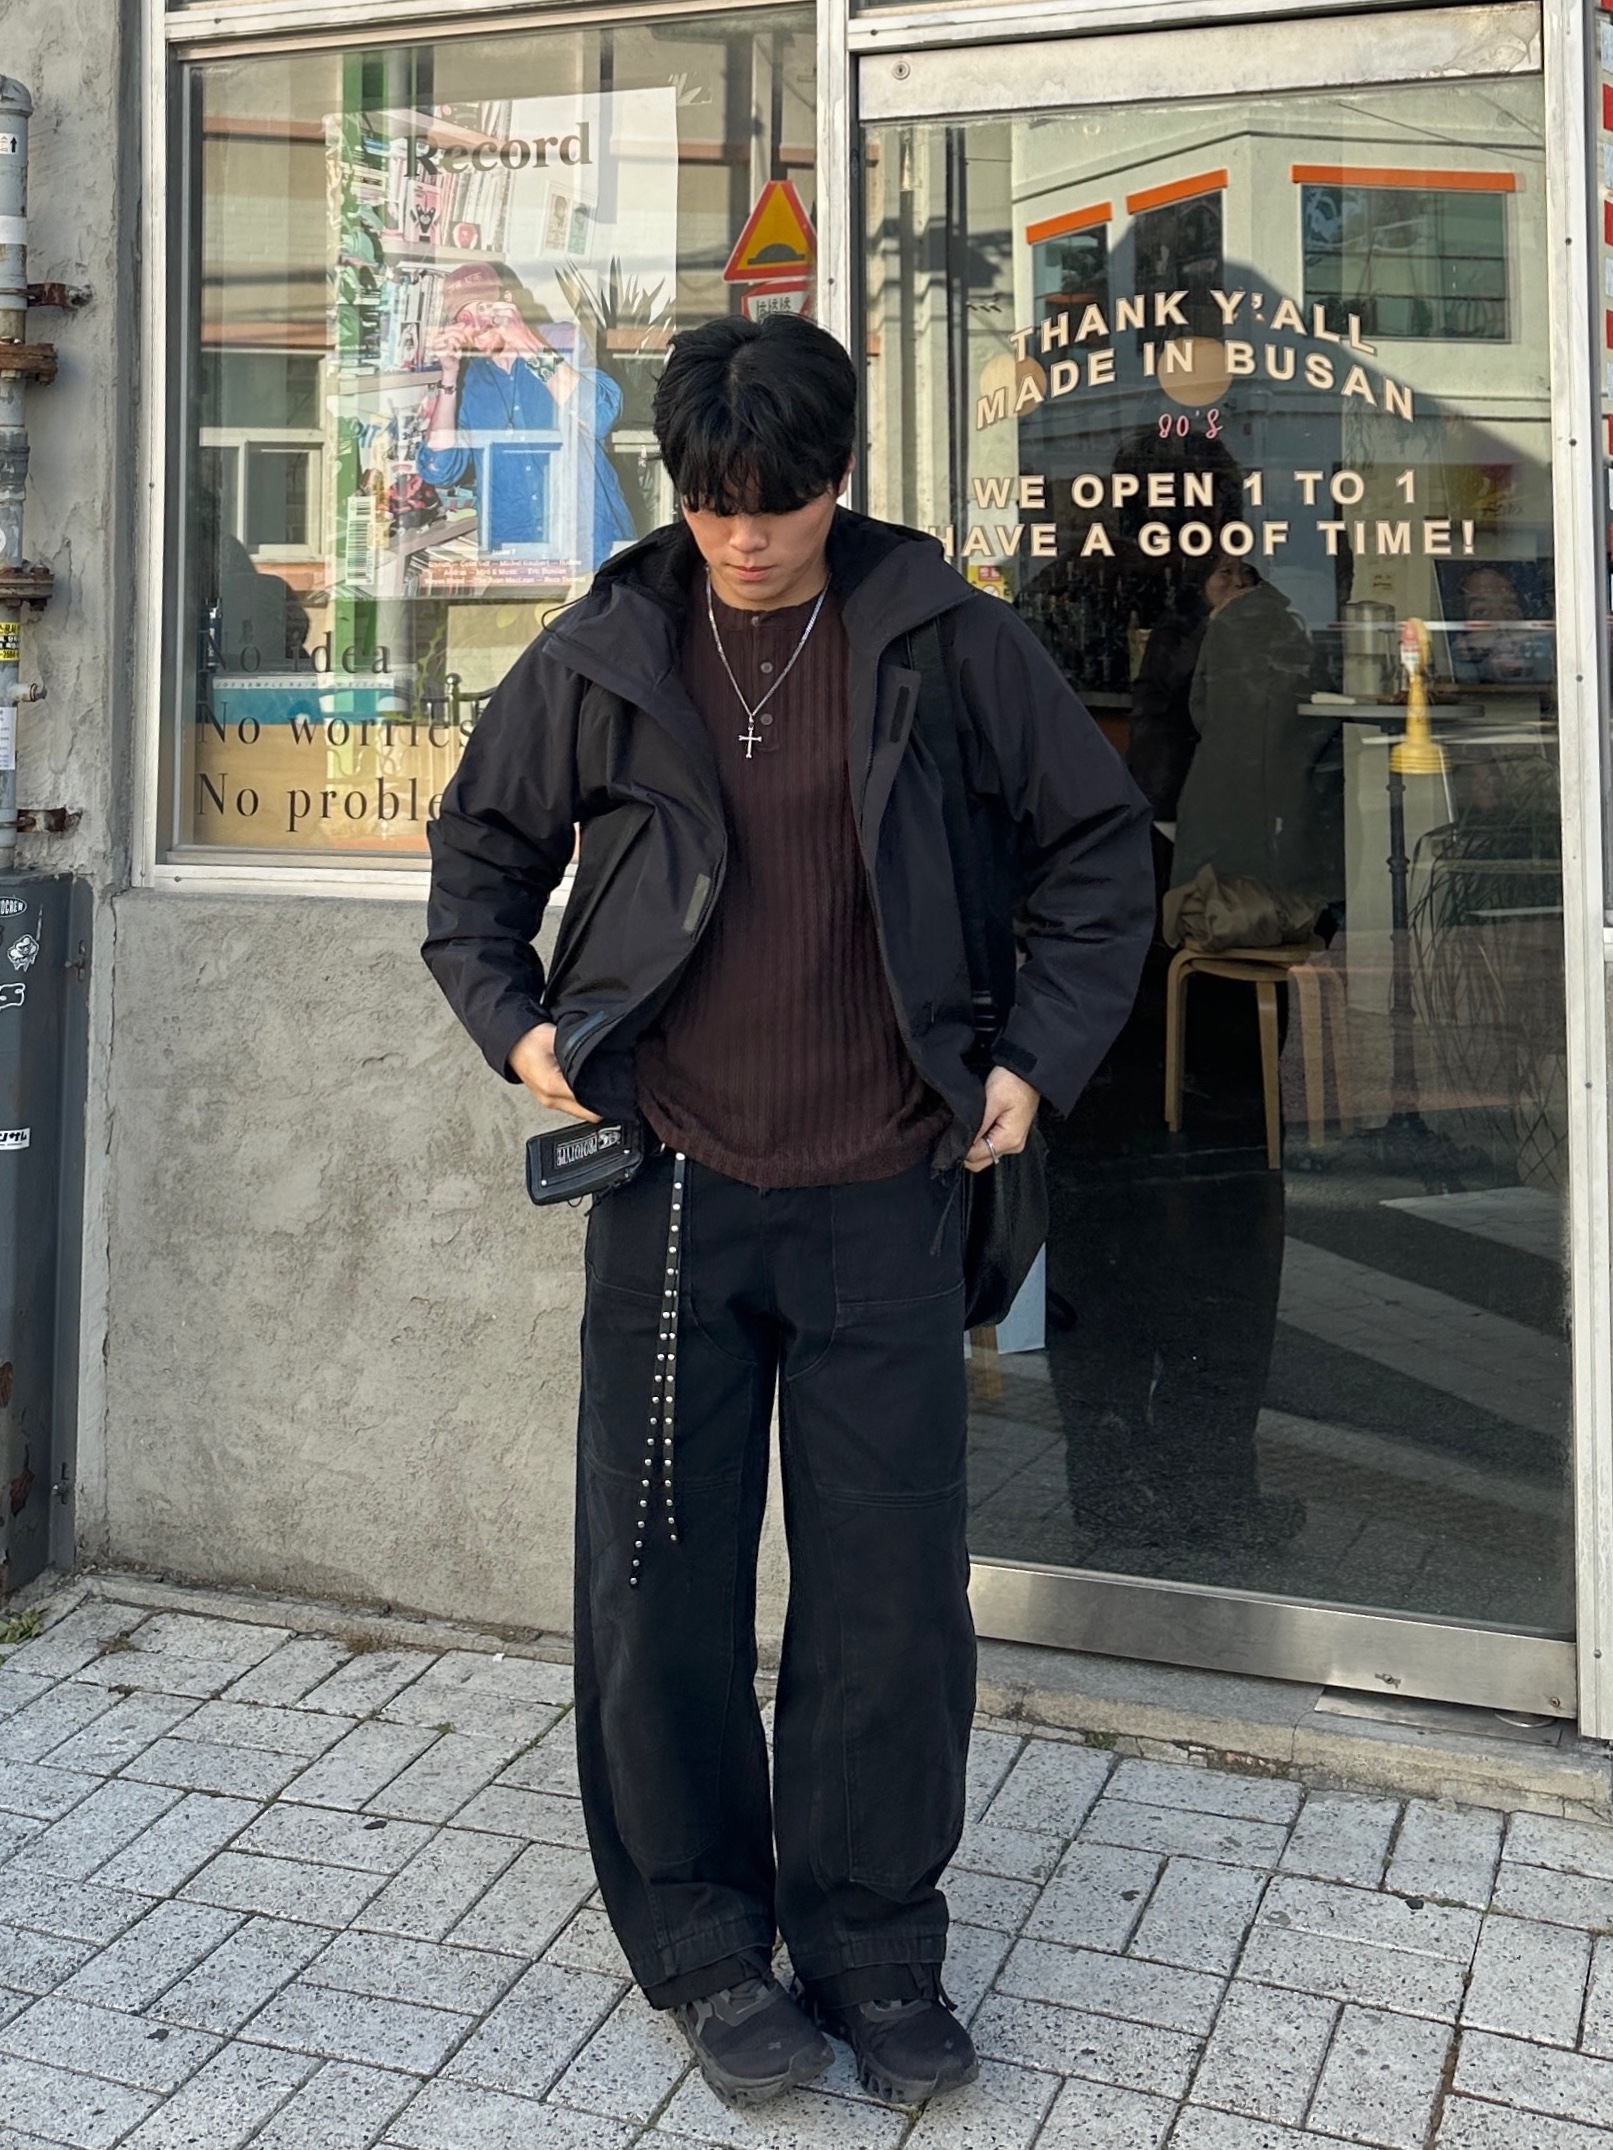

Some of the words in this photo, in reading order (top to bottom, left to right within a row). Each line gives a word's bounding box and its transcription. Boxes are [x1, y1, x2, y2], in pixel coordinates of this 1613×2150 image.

[404, 121, 592, 178] Record
[1009, 289, 1190, 363] THANK
[1210, 288, 1378, 357] Y'ALL
[976, 347, 1116, 431] MADE
[1143, 339, 1194, 378] IN
[1226, 338, 1414, 423] BUSAN
[973, 475, 1046, 509] WE
[1071, 471, 1213, 509] OPEN
[1243, 470, 1263, 507] 1
[1294, 469, 1365, 506] TO
[1395, 468, 1416, 504] 1
[1080, 522, 1116, 557] A
[1138, 519, 1289, 557] GOOF
[1317, 519, 1475, 556] TIME!
[199, 630, 260, 673] No
[289, 630, 393, 674] idea
[198, 701, 261, 746] No
[289, 716, 472, 748] worries
[197, 773, 259, 817] No
